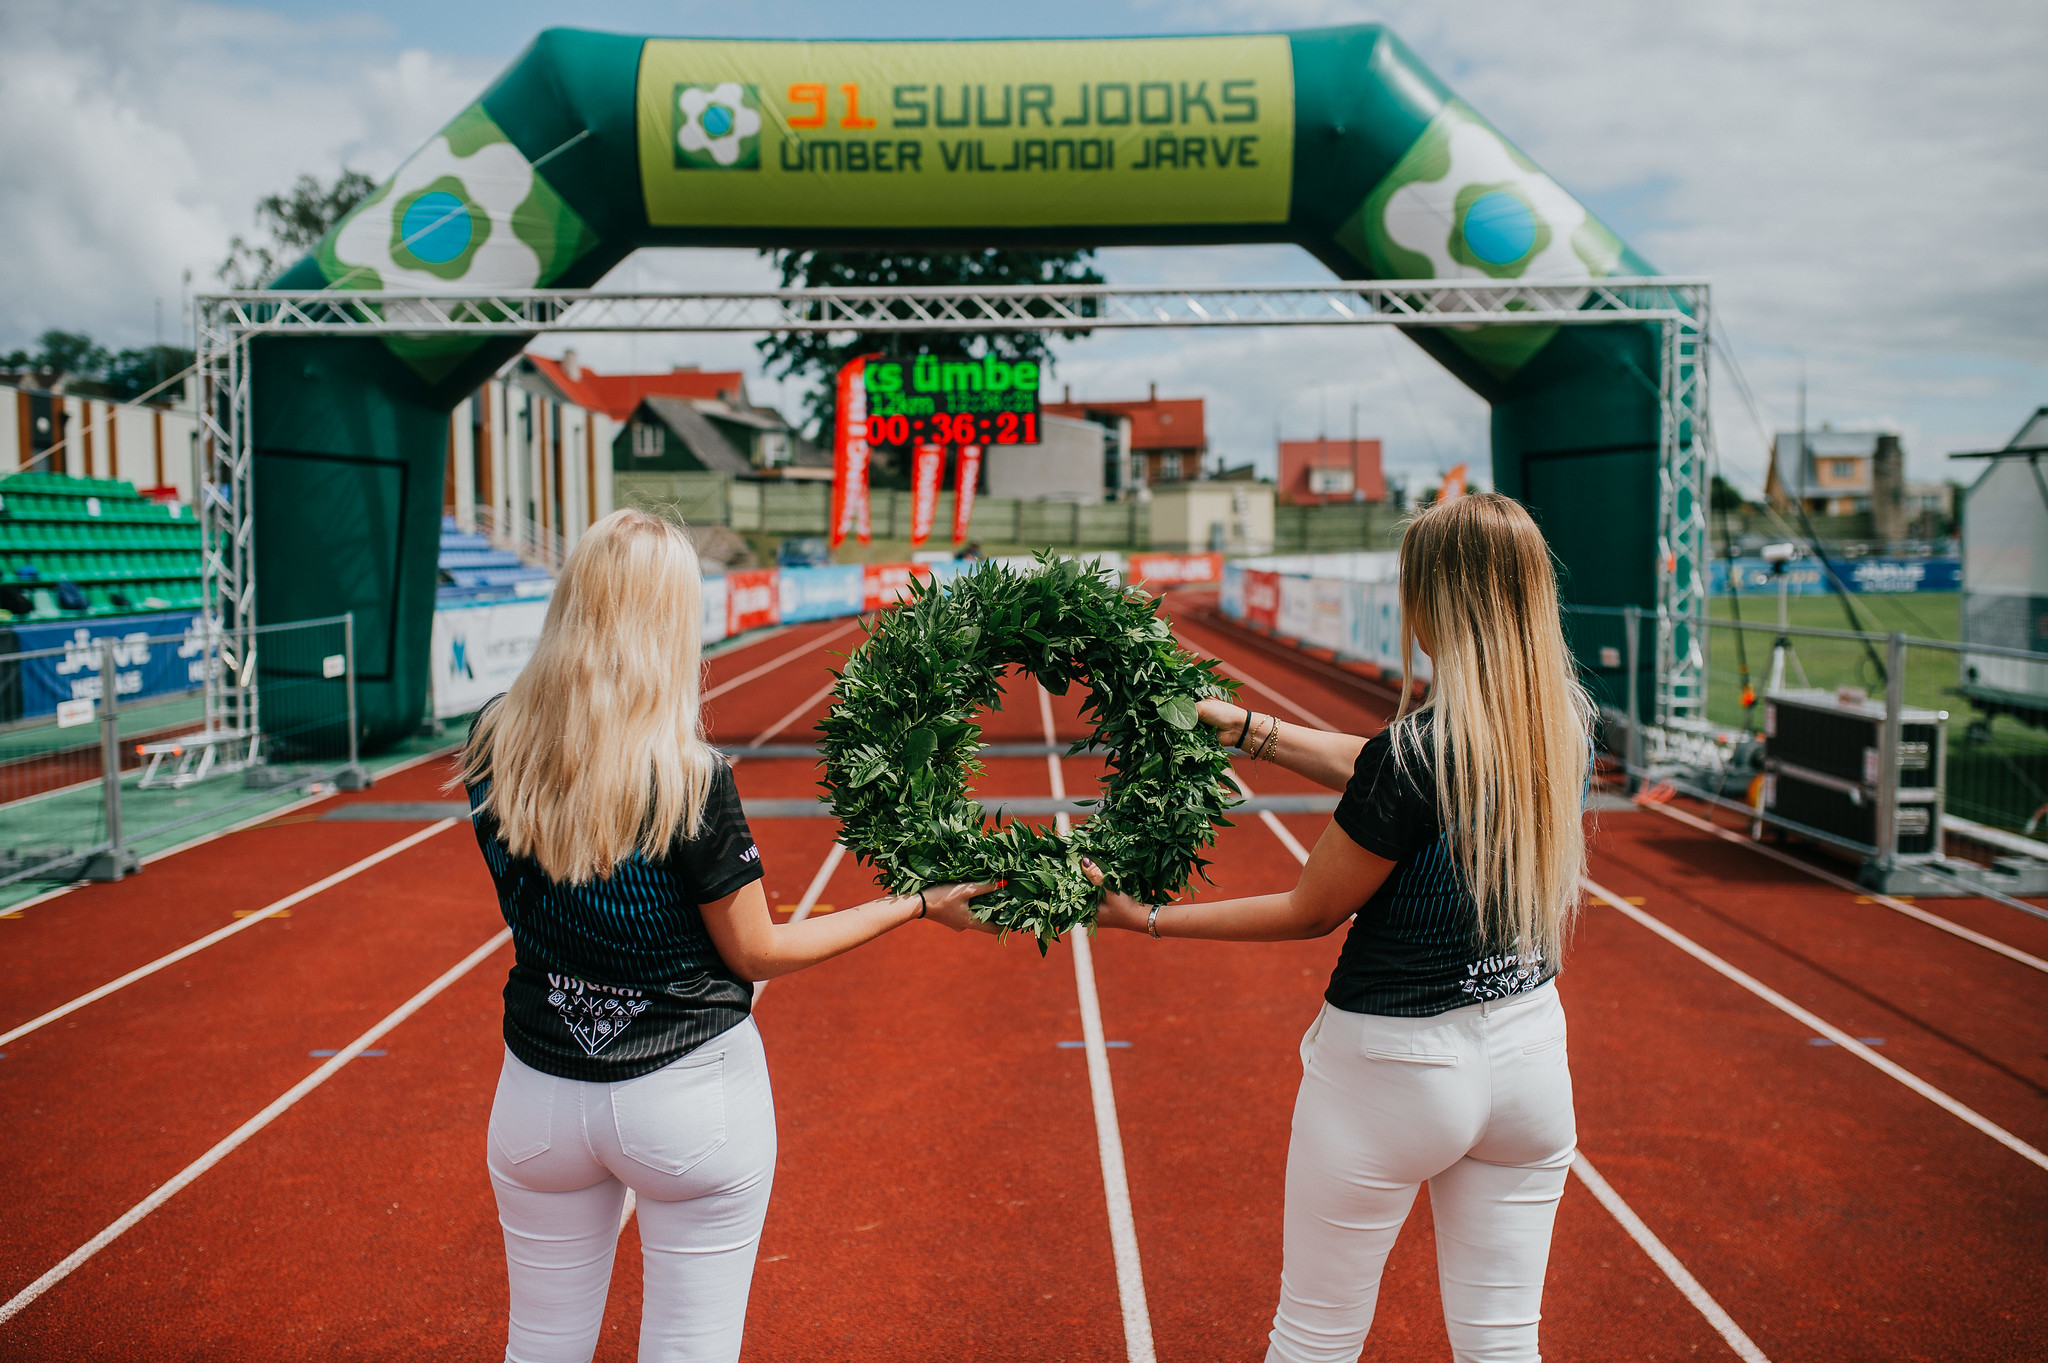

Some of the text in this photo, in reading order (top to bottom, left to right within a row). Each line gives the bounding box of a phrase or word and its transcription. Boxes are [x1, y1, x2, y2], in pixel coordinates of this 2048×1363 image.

[787, 80, 1258, 129] 91. SUURJOOKS
[780, 130, 1258, 171] ÜMBER VILJANDI JÄRVE
[864, 412, 1039, 446] 00:36:21
